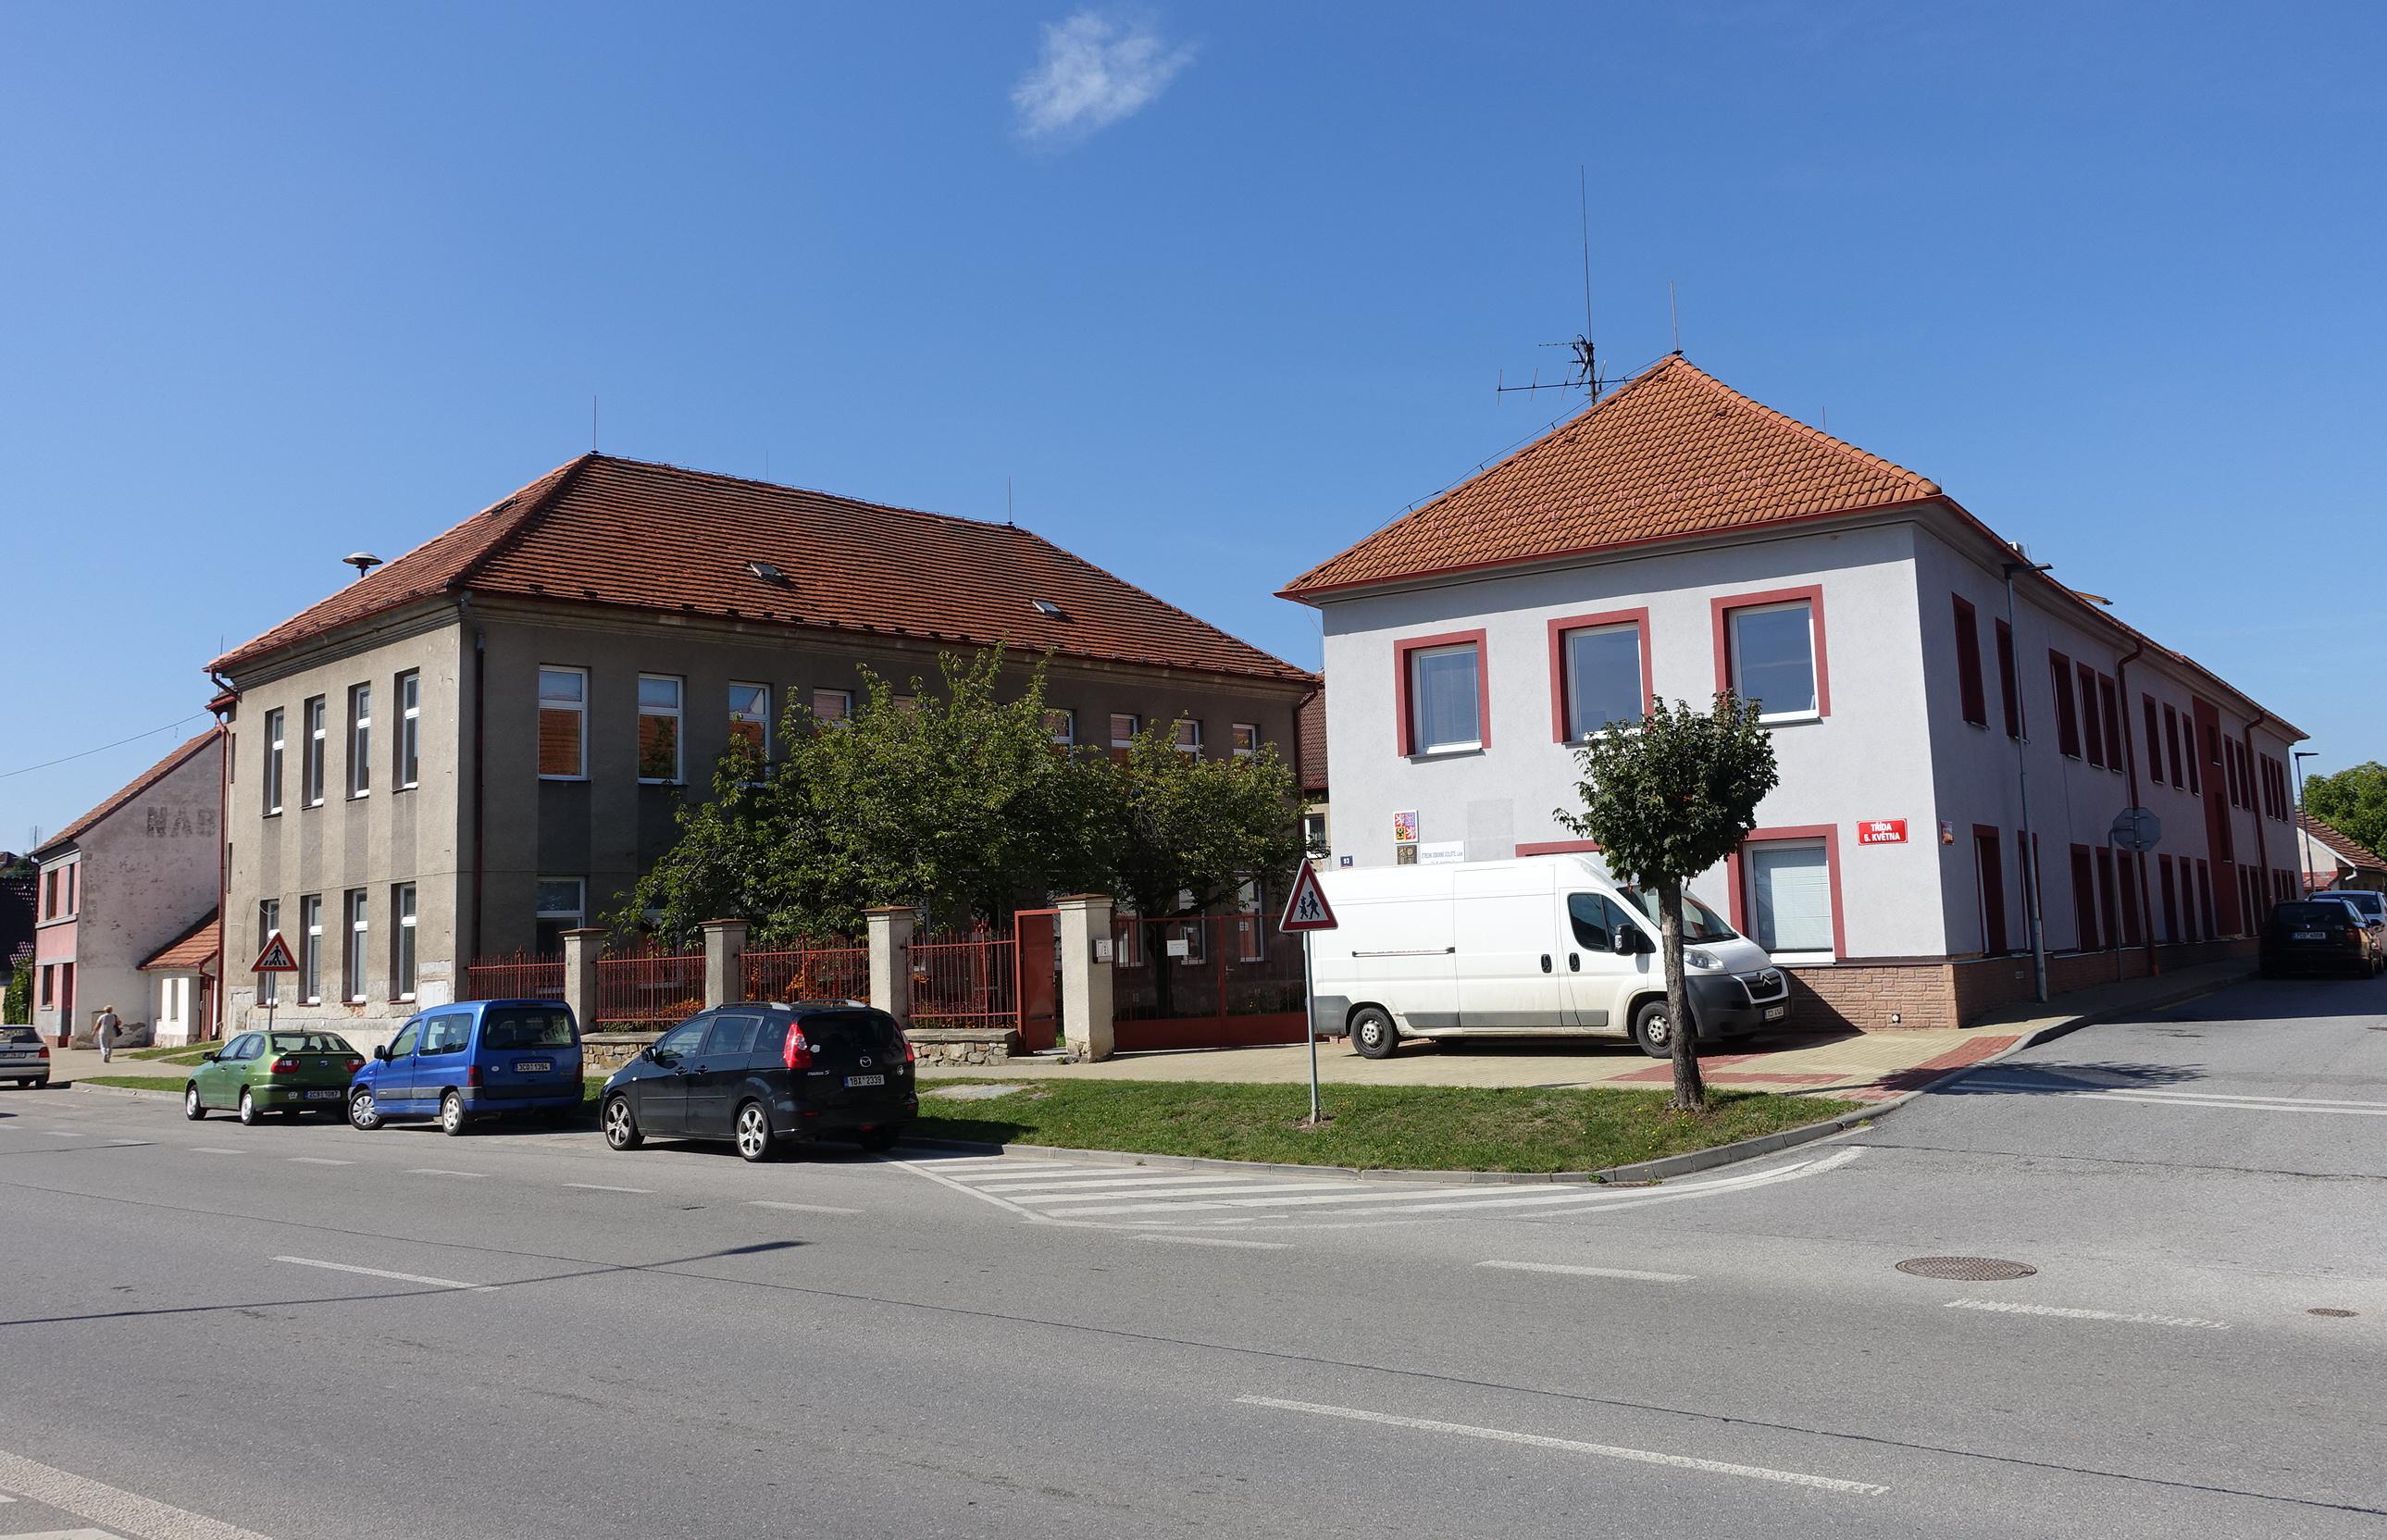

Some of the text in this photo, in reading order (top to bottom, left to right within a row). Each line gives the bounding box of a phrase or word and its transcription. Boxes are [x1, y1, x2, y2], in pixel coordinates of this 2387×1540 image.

[1871, 821, 1892, 831] TŘÍDA
[1864, 831, 1900, 842] 5. KVĚTNA
[850, 1075, 882, 1086] 1BX 2339
